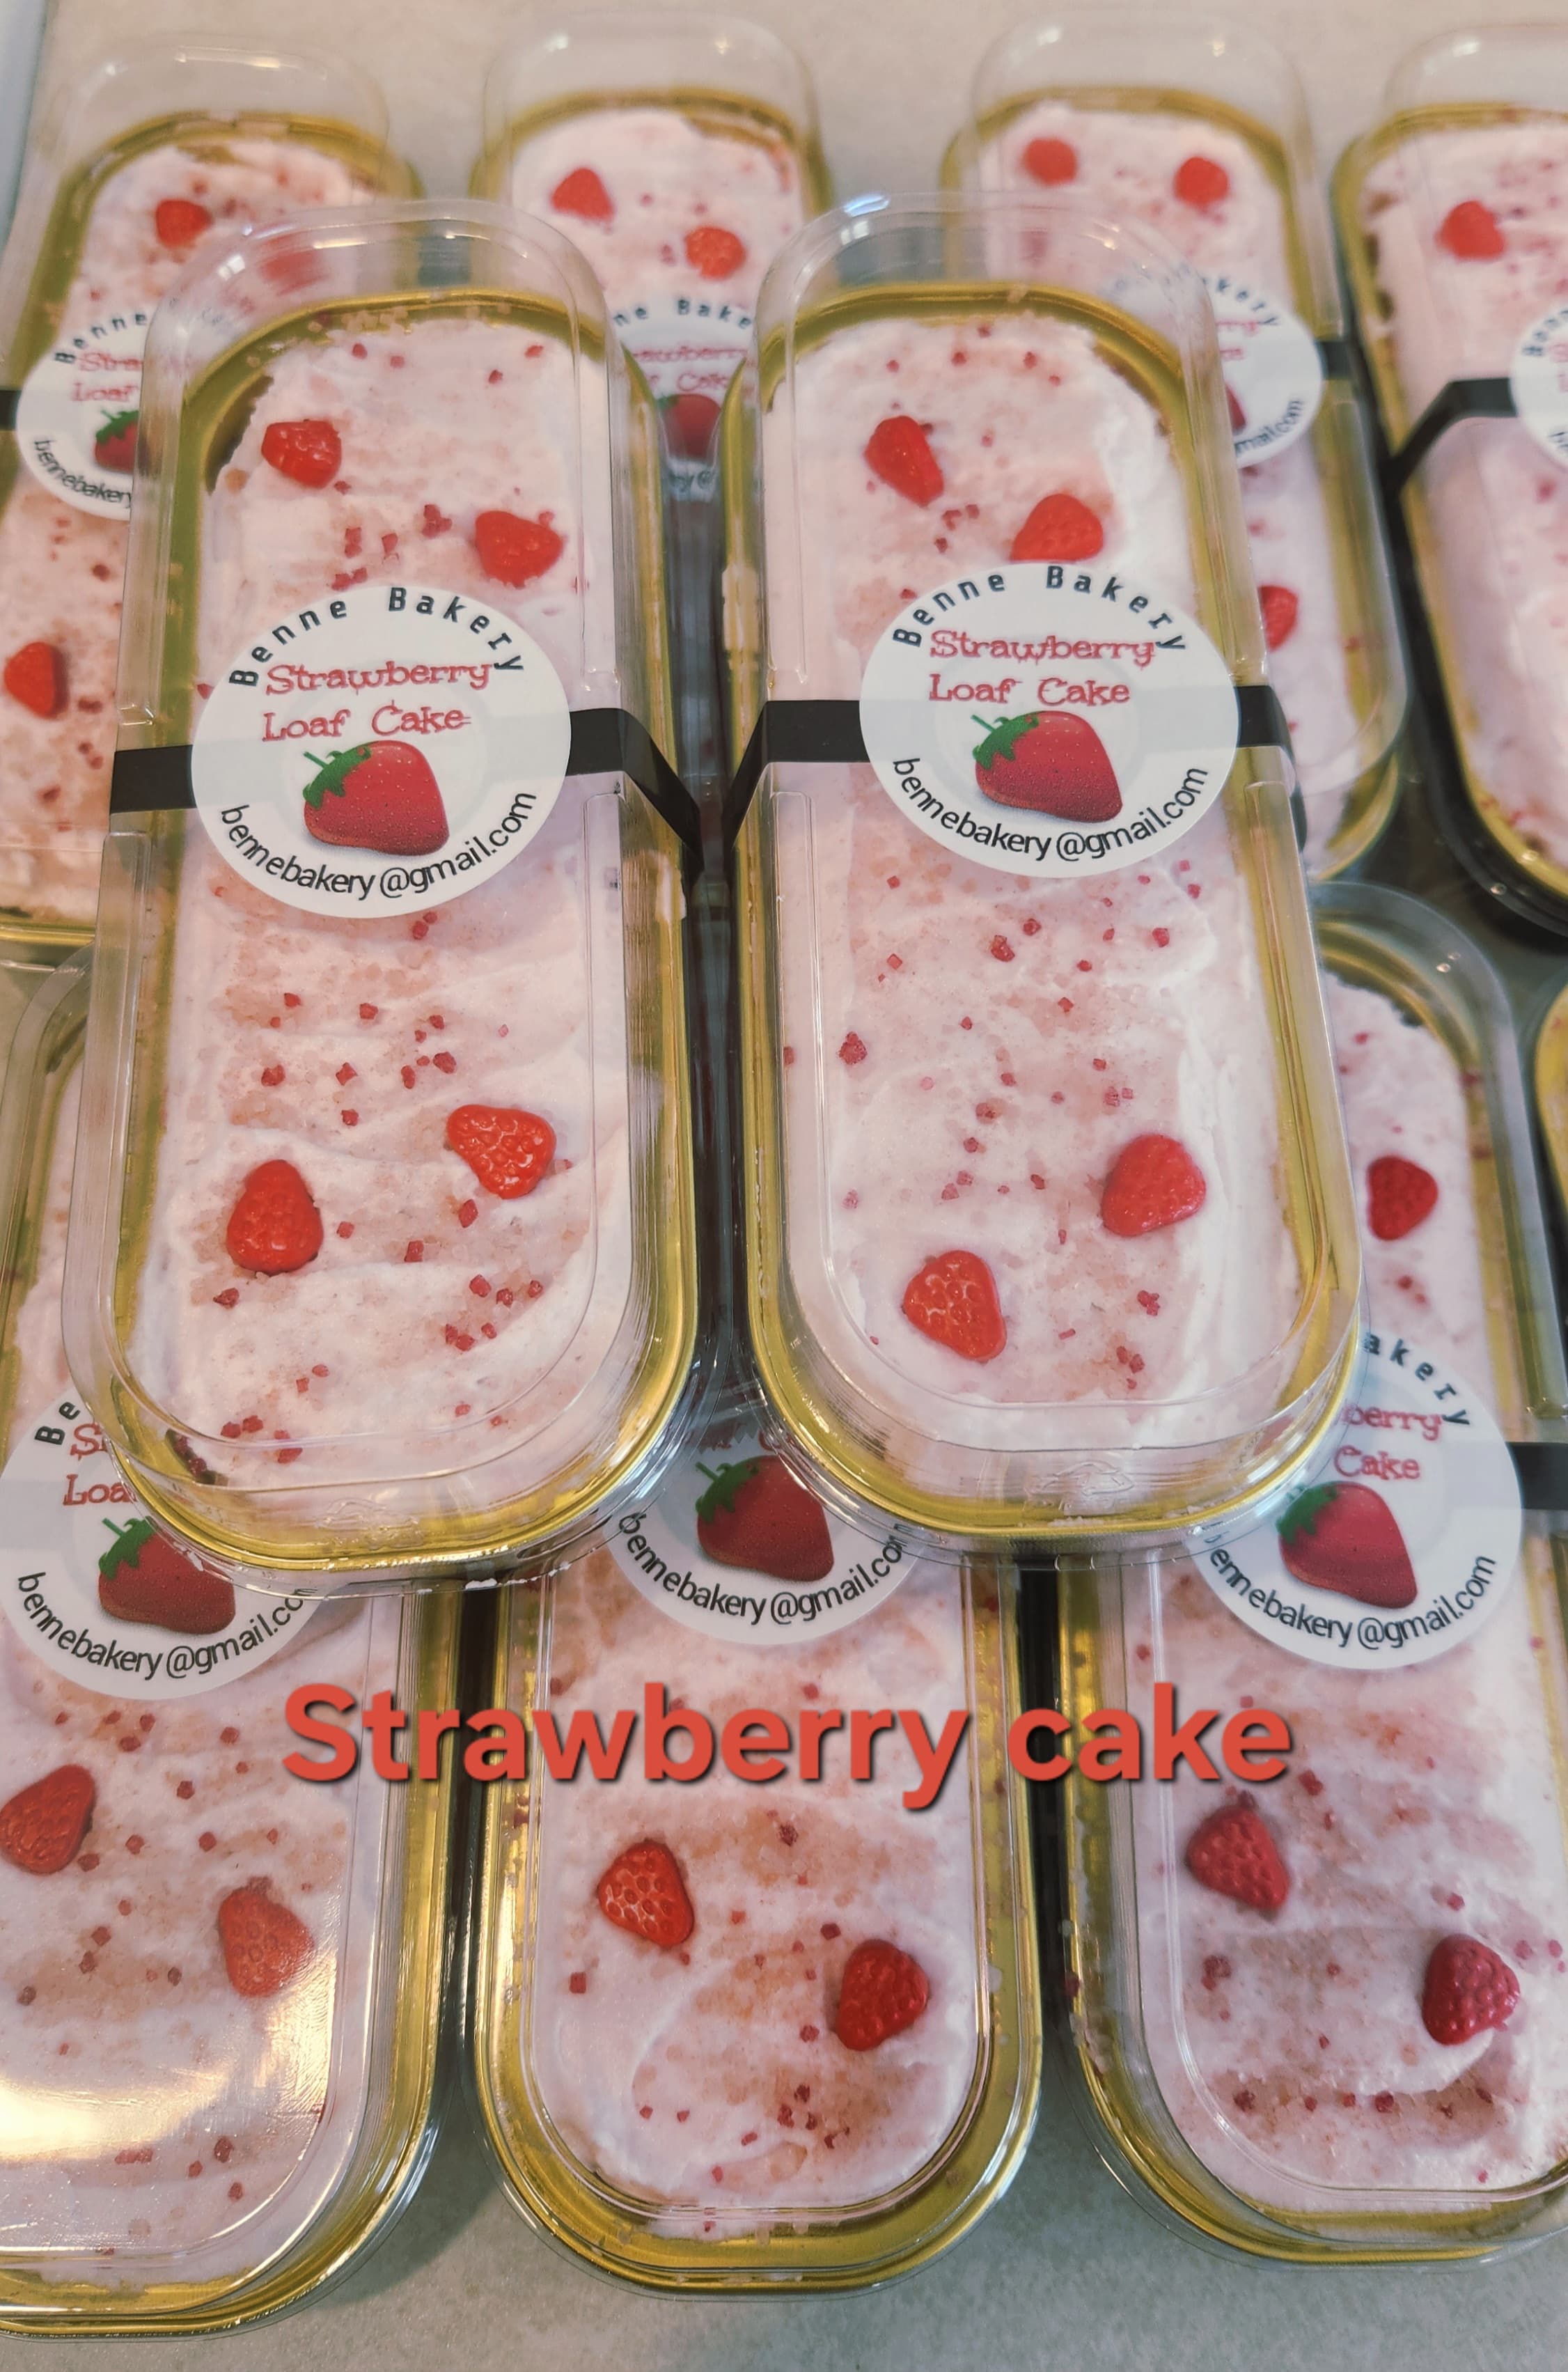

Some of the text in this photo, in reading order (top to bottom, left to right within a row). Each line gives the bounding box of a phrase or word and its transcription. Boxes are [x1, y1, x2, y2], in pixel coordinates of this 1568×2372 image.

[677, 299, 752, 329] Bake
[892, 565, 1186, 650] Benne Bakery
[228, 586, 524, 687] Benne Bakery
[930, 630, 1157, 667] Strawberry
[266, 662, 491, 695] Strawberry
[928, 673, 1131, 707] Loaf Cake
[262, 700, 471, 742] Loaf Cake
[892, 758, 1209, 861] bennebakery@gmail.com
[221, 791, 538, 900] bennebakery@gmail.com
[1364, 1332, 1470, 1425] akery
[1333, 1444, 1421, 1481] Cake
[63, 1474, 138, 1506] Loa
